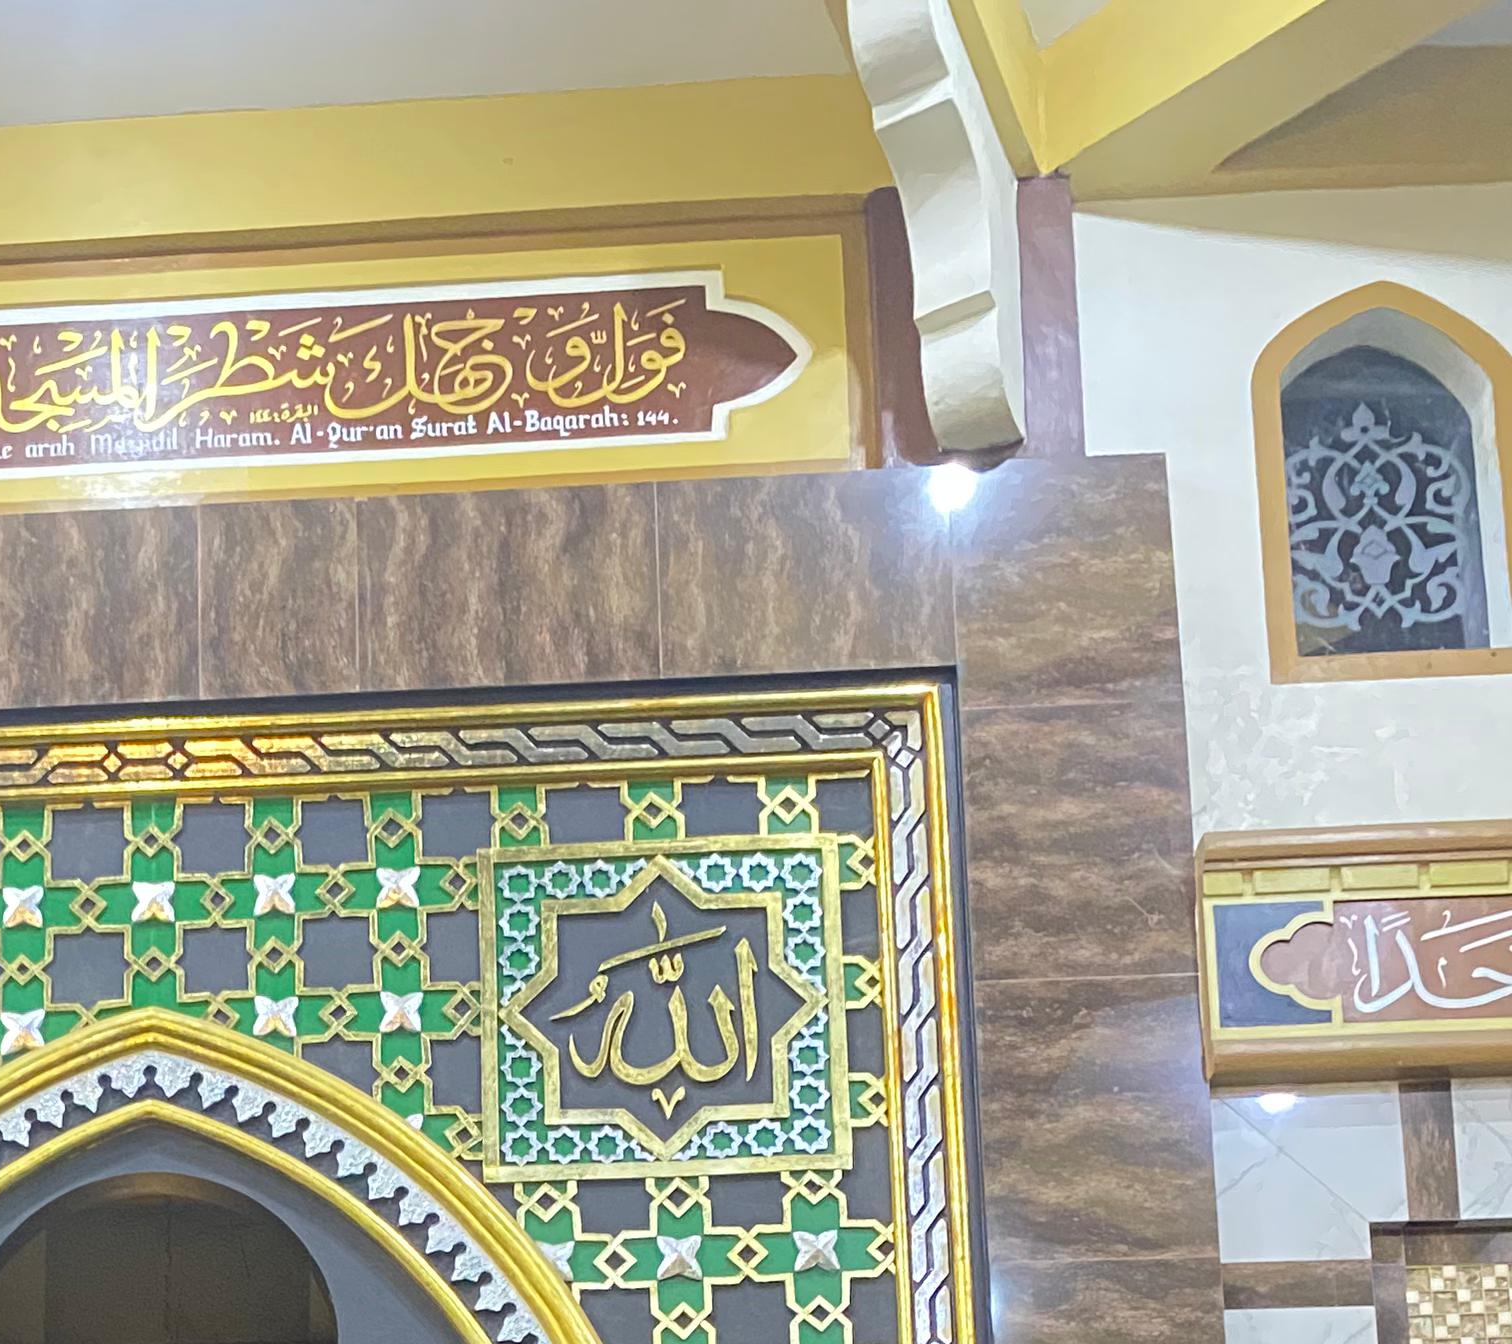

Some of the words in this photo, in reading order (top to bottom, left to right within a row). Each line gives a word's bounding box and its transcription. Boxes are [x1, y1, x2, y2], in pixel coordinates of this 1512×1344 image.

[24, 434, 76, 459] arah
[194, 427, 281, 449] Haram.
[410, 414, 478, 440] Surat
